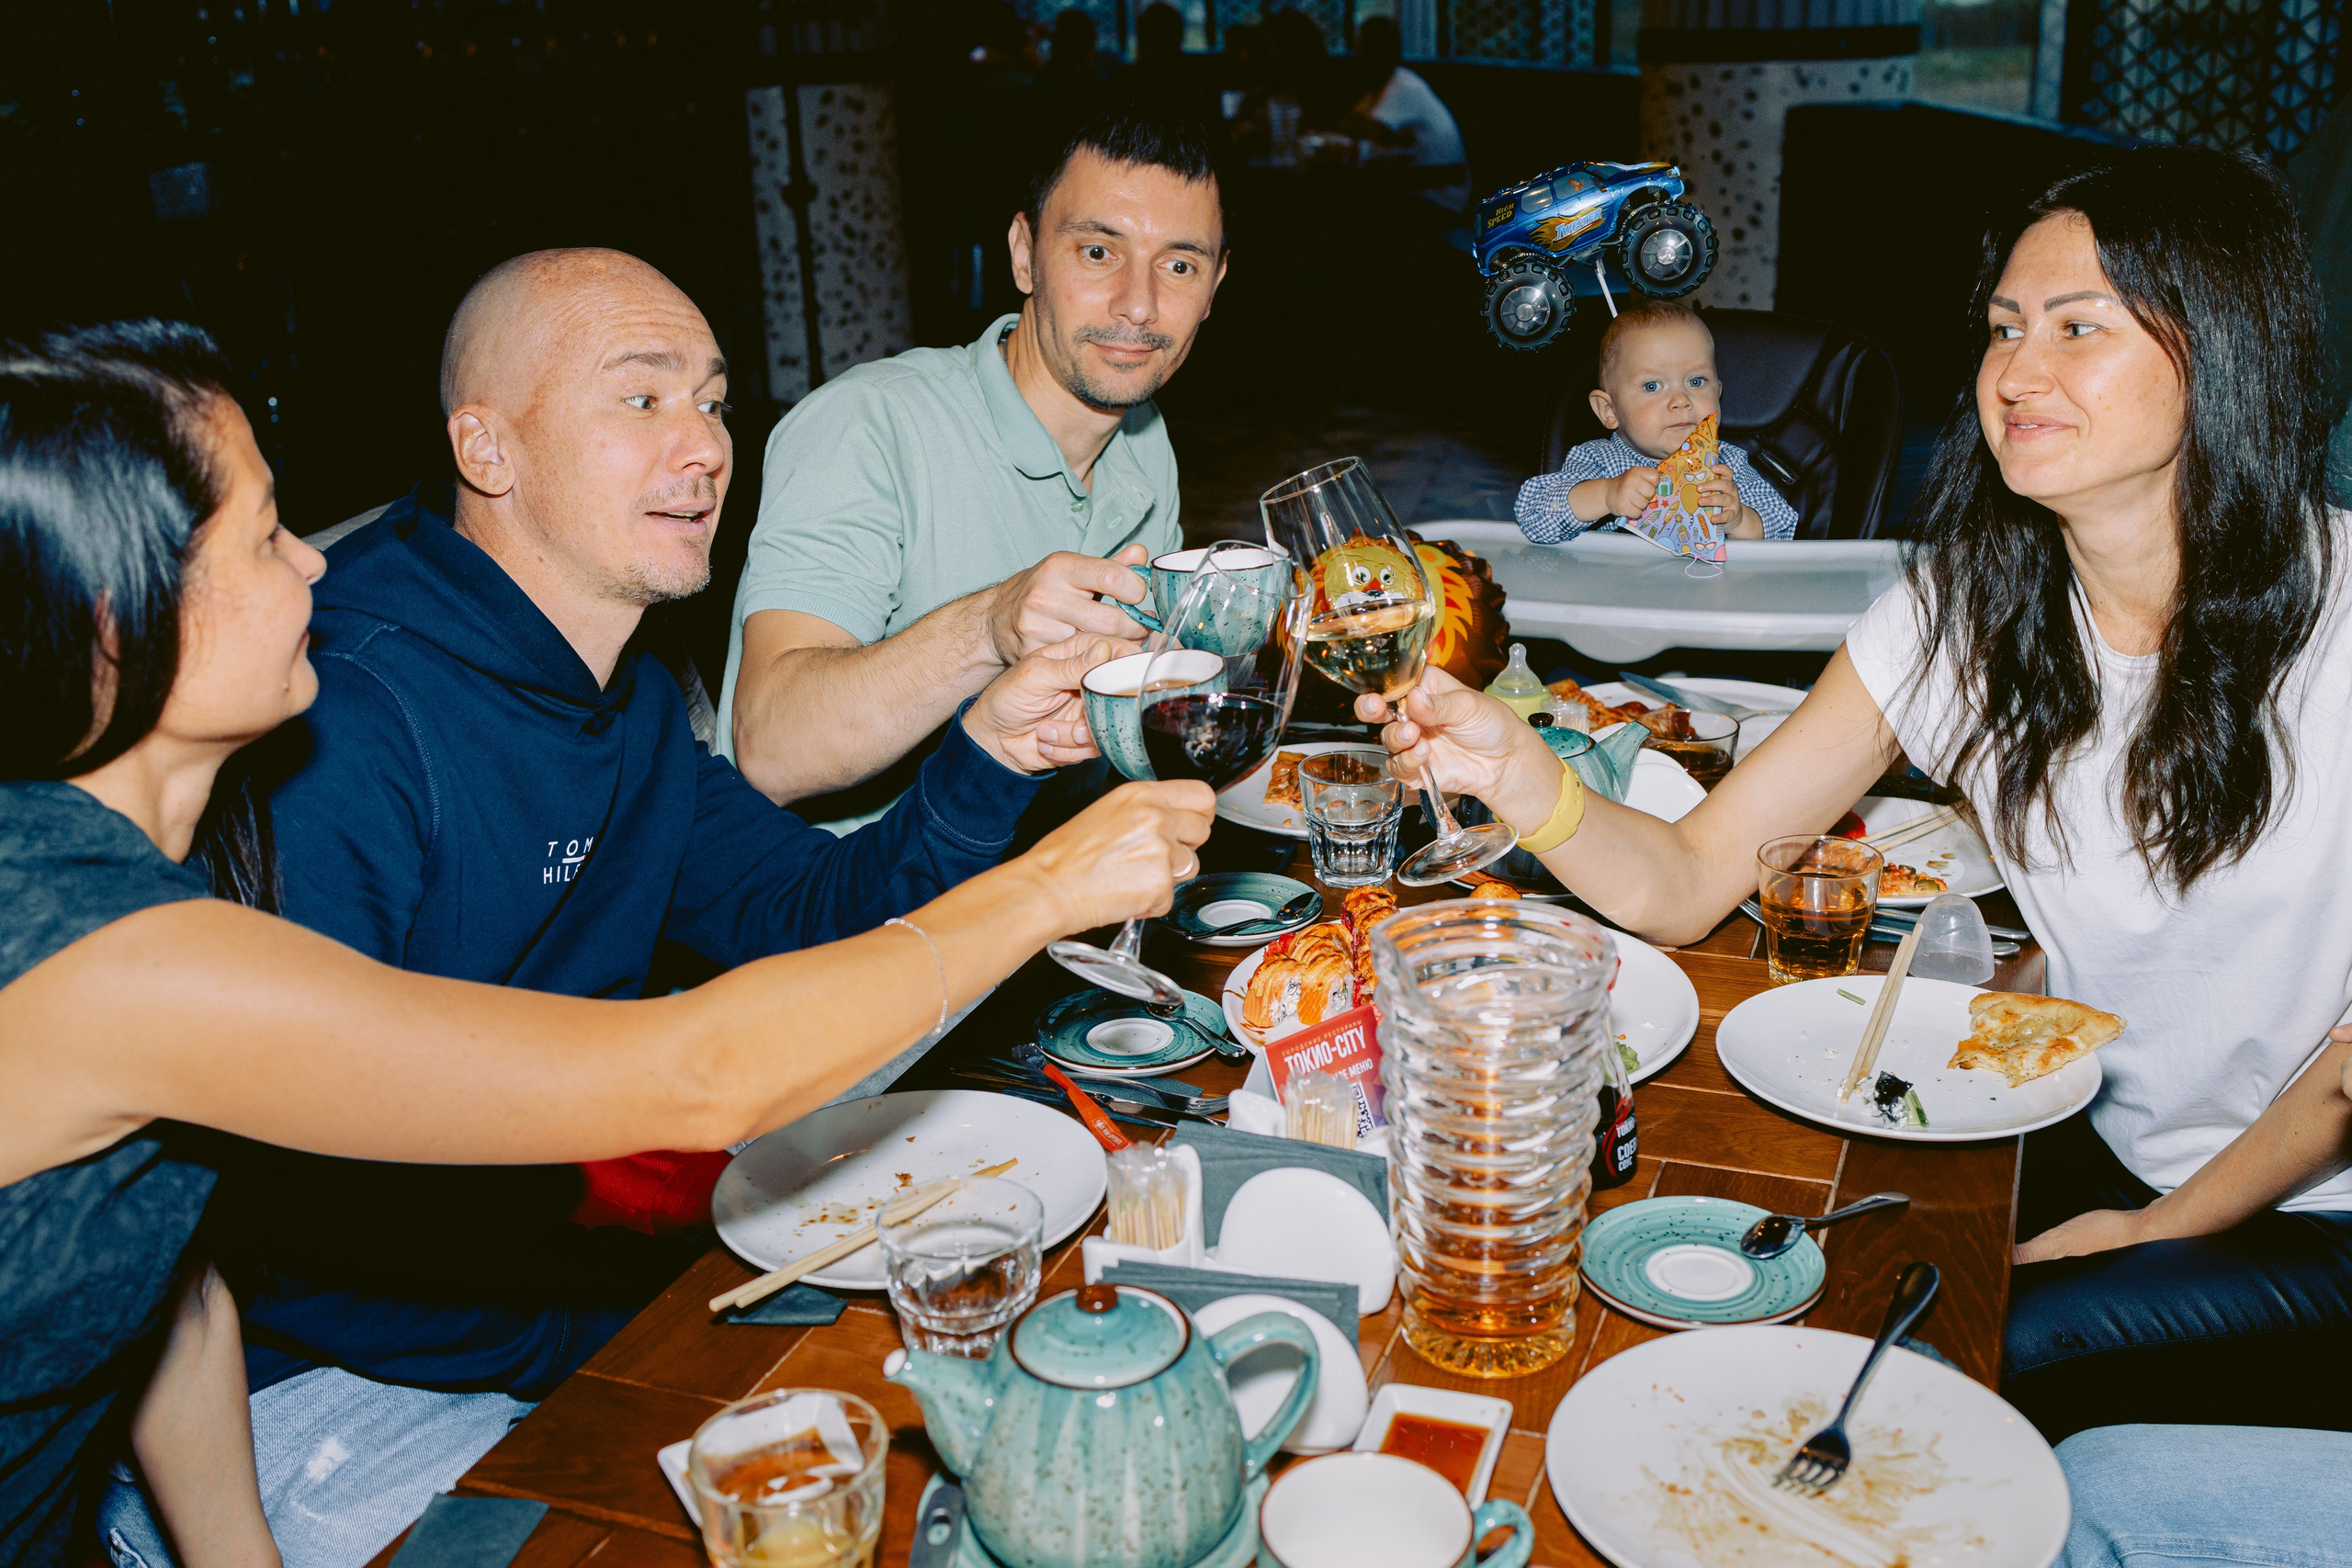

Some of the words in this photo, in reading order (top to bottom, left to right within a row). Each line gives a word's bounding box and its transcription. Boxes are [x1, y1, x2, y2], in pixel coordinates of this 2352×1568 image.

[1487, 209, 1512, 229] SPEED
[1495, 202, 1515, 217] HIGH
[1555, 207, 1602, 240] TWISTER
[1282, 1036, 1322, 1057] ГОРОДСКИЕ
[1324, 1020, 1363, 1039] РЕСТОРАНЫ
[1283, 1025, 1366, 1077] ТОКИО-CITY
[1348, 1057, 1374, 1077] МЕНЮ
